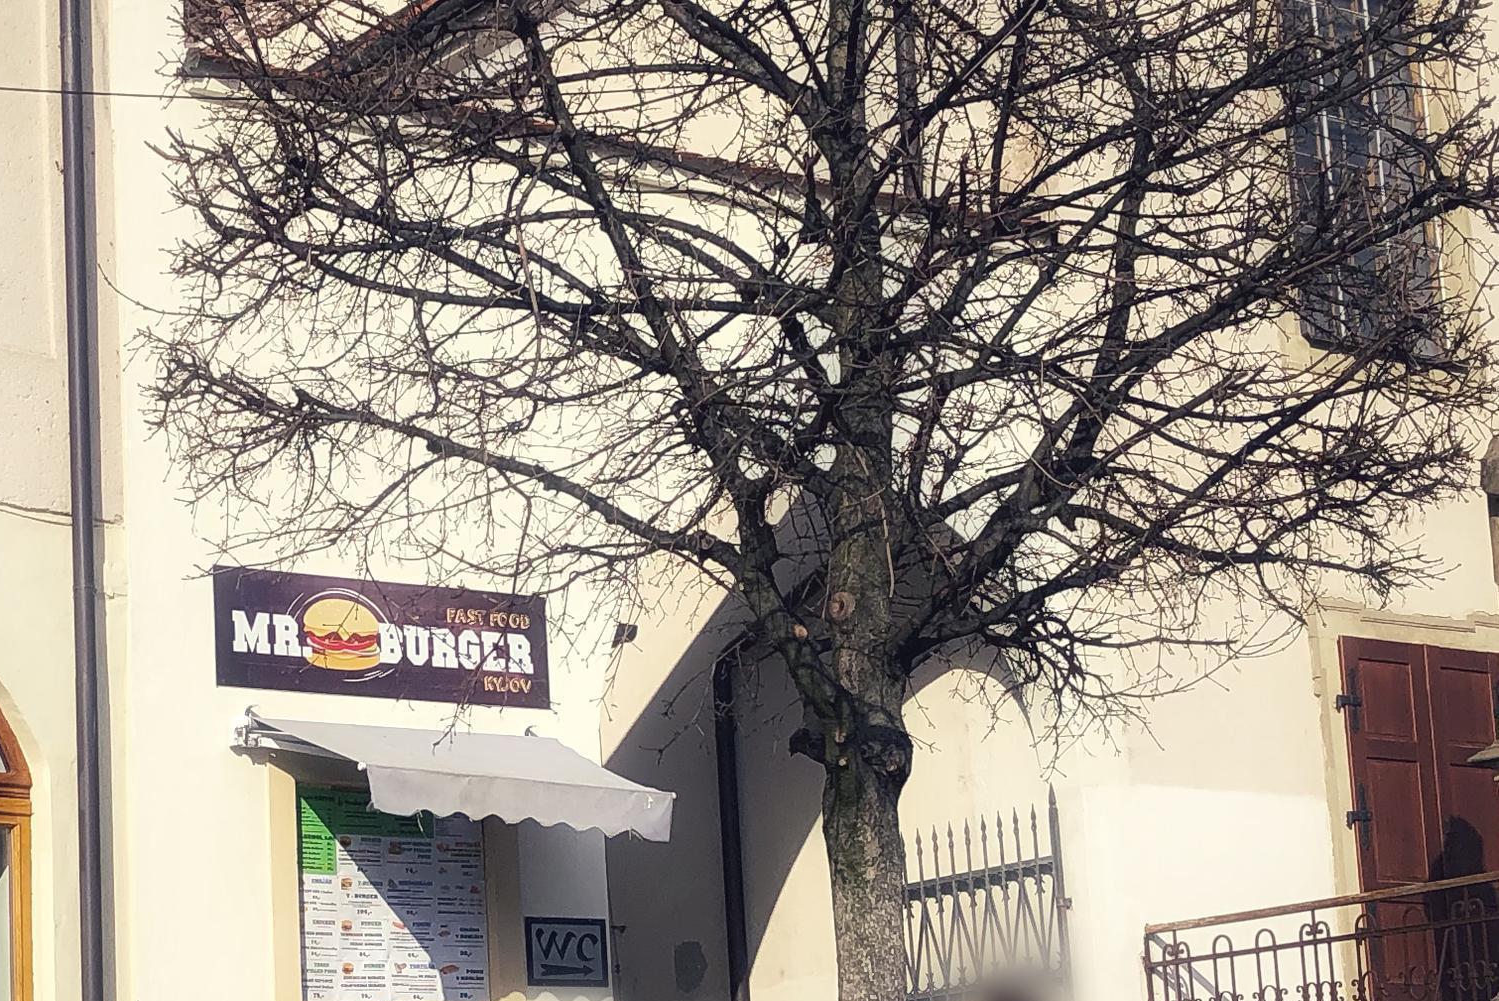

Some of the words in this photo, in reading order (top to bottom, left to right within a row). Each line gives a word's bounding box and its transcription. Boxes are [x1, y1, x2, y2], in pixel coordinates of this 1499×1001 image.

[446, 607, 487, 627] FAST
[489, 610, 531, 630] FOOD
[379, 622, 535, 674] BURGER
[484, 675, 532, 694] KYJOV
[535, 927, 599, 961] WC
